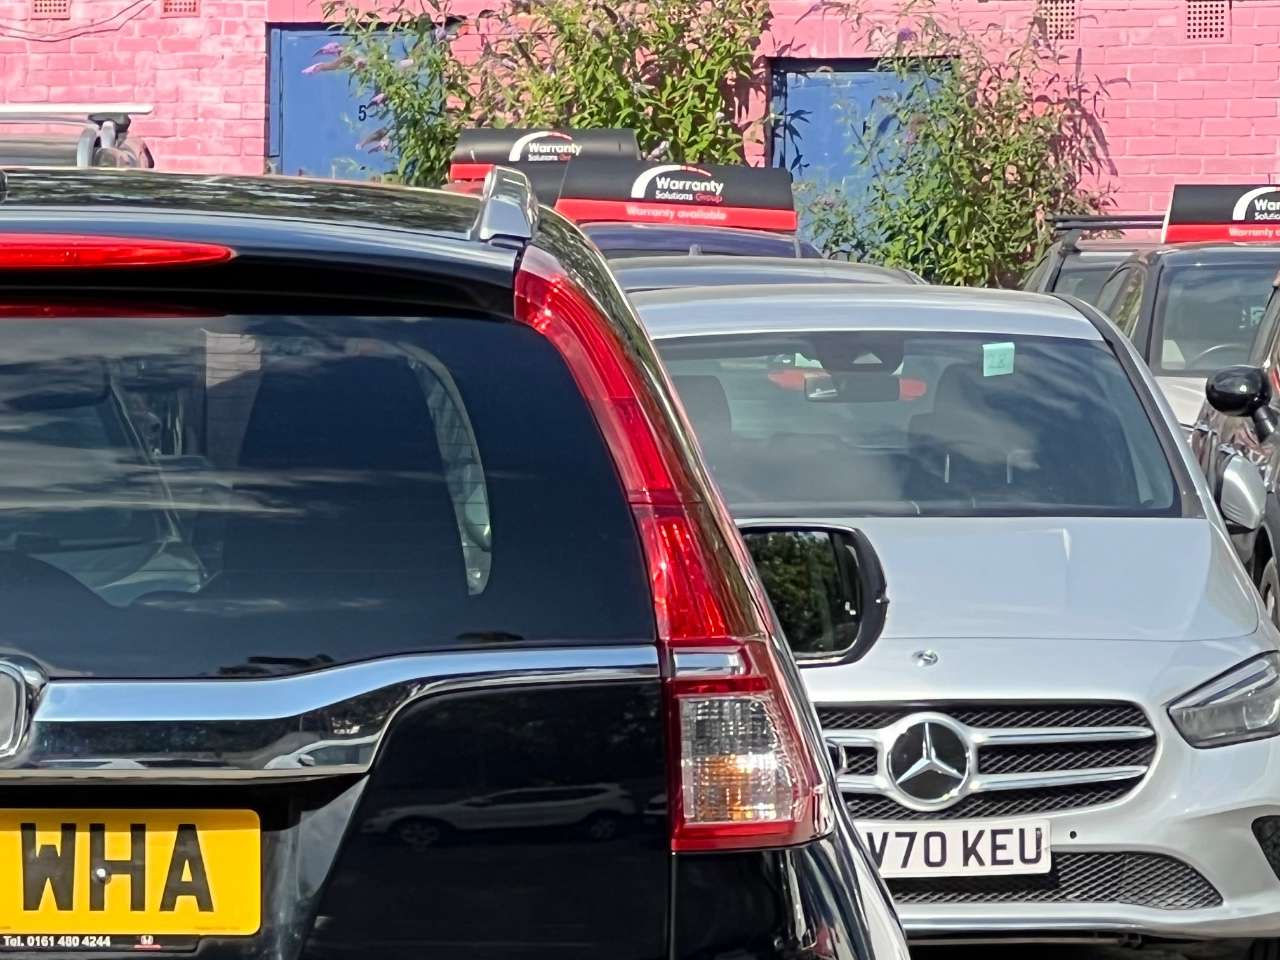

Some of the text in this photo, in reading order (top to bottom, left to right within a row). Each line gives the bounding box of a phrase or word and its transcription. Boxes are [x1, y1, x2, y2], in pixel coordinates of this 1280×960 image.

[358, 104, 367, 122] 5
[528, 143, 582, 156] Warranty
[528, 154, 558, 162] Solutions
[656, 176, 724, 195] Warranty
[655, 190, 722, 203] Solutions Group
[626, 206, 727, 221] Warranty available
[1228, 227, 1274, 238] Warranty
[962, 827, 1043, 867] KEU
[20, 822, 215, 912] WHA
[2, 935, 24, 947] Tel.
[26, 935, 55, 947] 0161
[57, 935, 80, 947] 480
[81, 935, 111, 947] 4244
